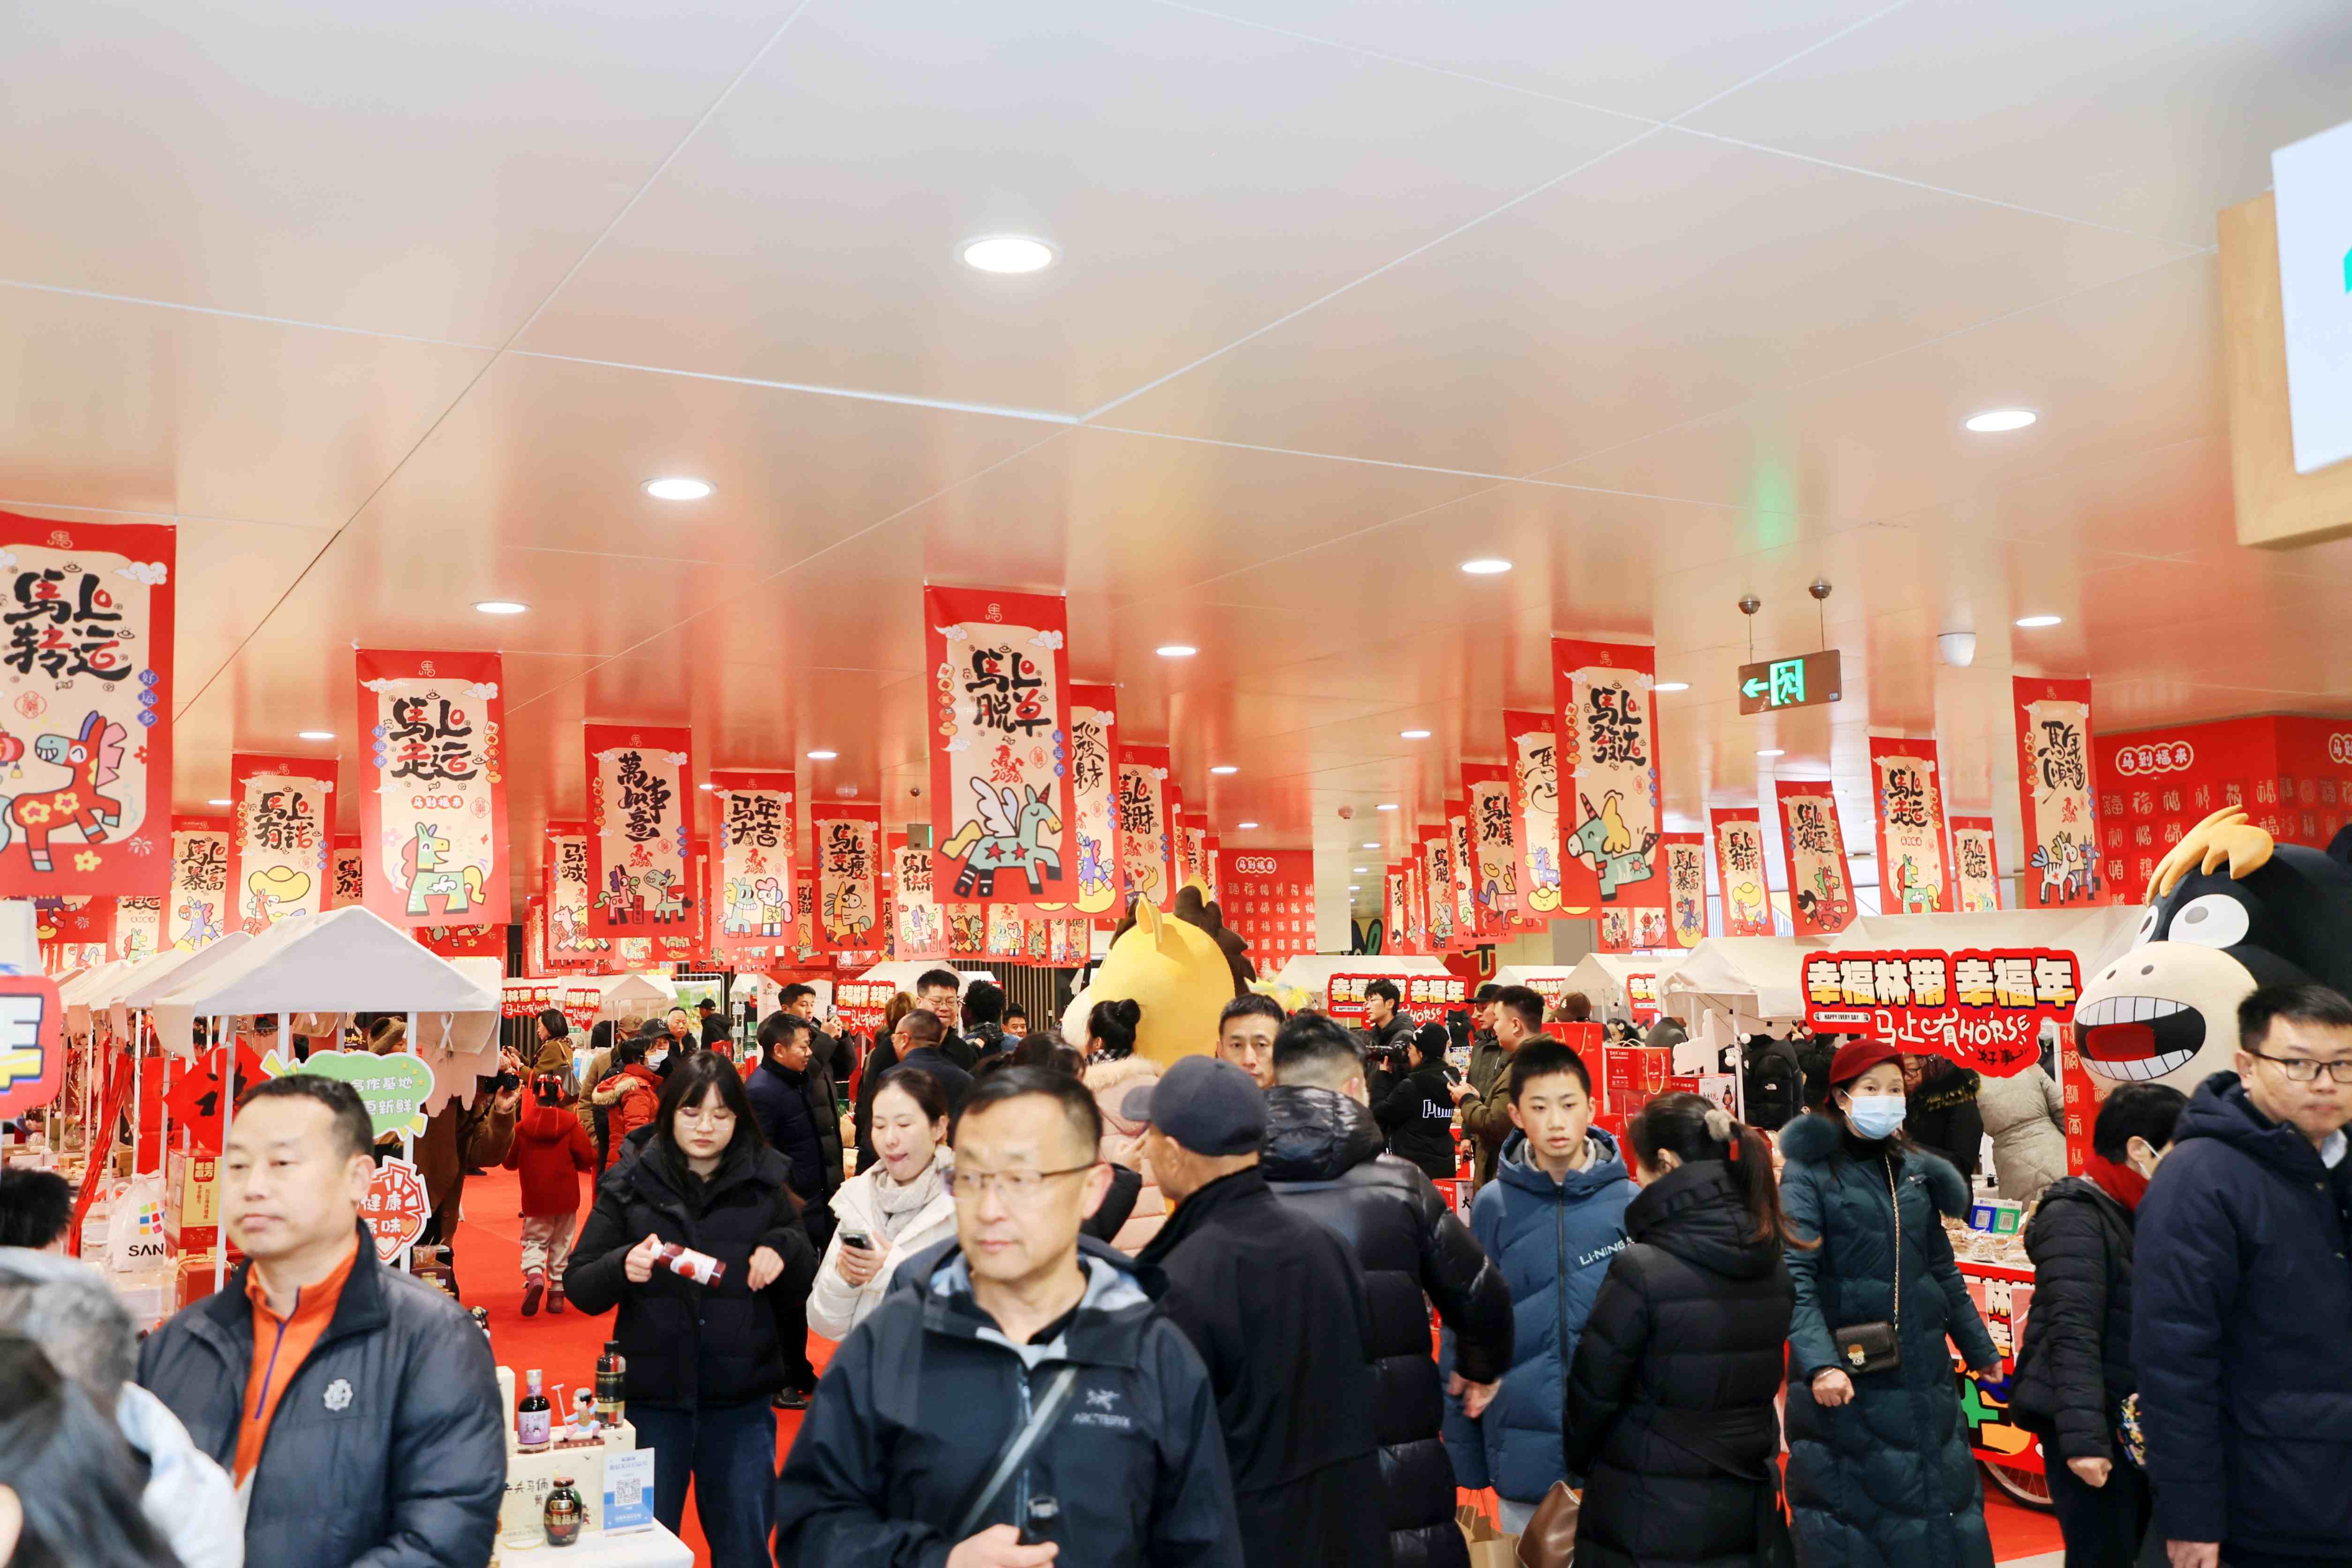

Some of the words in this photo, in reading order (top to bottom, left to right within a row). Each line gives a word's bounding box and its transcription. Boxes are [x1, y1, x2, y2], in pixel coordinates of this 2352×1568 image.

[965, 648, 1042, 693] 馬上
[390, 697, 472, 742] 馬上
[973, 689, 1051, 737] 脱单
[1589, 687, 1642, 726] 馬上
[391, 739, 477, 781] 走运
[2121, 747, 2188, 769] 马到福来
[990, 770, 1024, 783] 2026
[1888, 768, 1923, 799] 馬上
[254, 792, 314, 821] 馬上
[413, 797, 461, 808] 马到福来
[731, 794, 781, 822] 马年
[1891, 797, 1928, 827] 走运
[1797, 804, 1824, 831] 馬上
[255, 816, 314, 849] 有钱
[731, 821, 781, 848] 大吉
[829, 823, 865, 854] 馬上
[1728, 832, 1756, 854] 馬上
[181, 838, 227, 865] 馬上
[563, 842, 587, 864] 马
[1238, 859, 1274, 870] 马到福来
[562, 864, 588, 884] 成
[1332, 978, 1406, 1003] 幸福带
[1410, 979, 1465, 1004] 幸福年
[1807, 958, 1946, 1007] 幸福林带
[1954, 957, 2076, 1008] 幸福年
[339, 1076, 413, 1092] 合作基地
[360, 1191, 402, 1211] 健康
[1579, 1240, 1626, 1266] LI-NING
